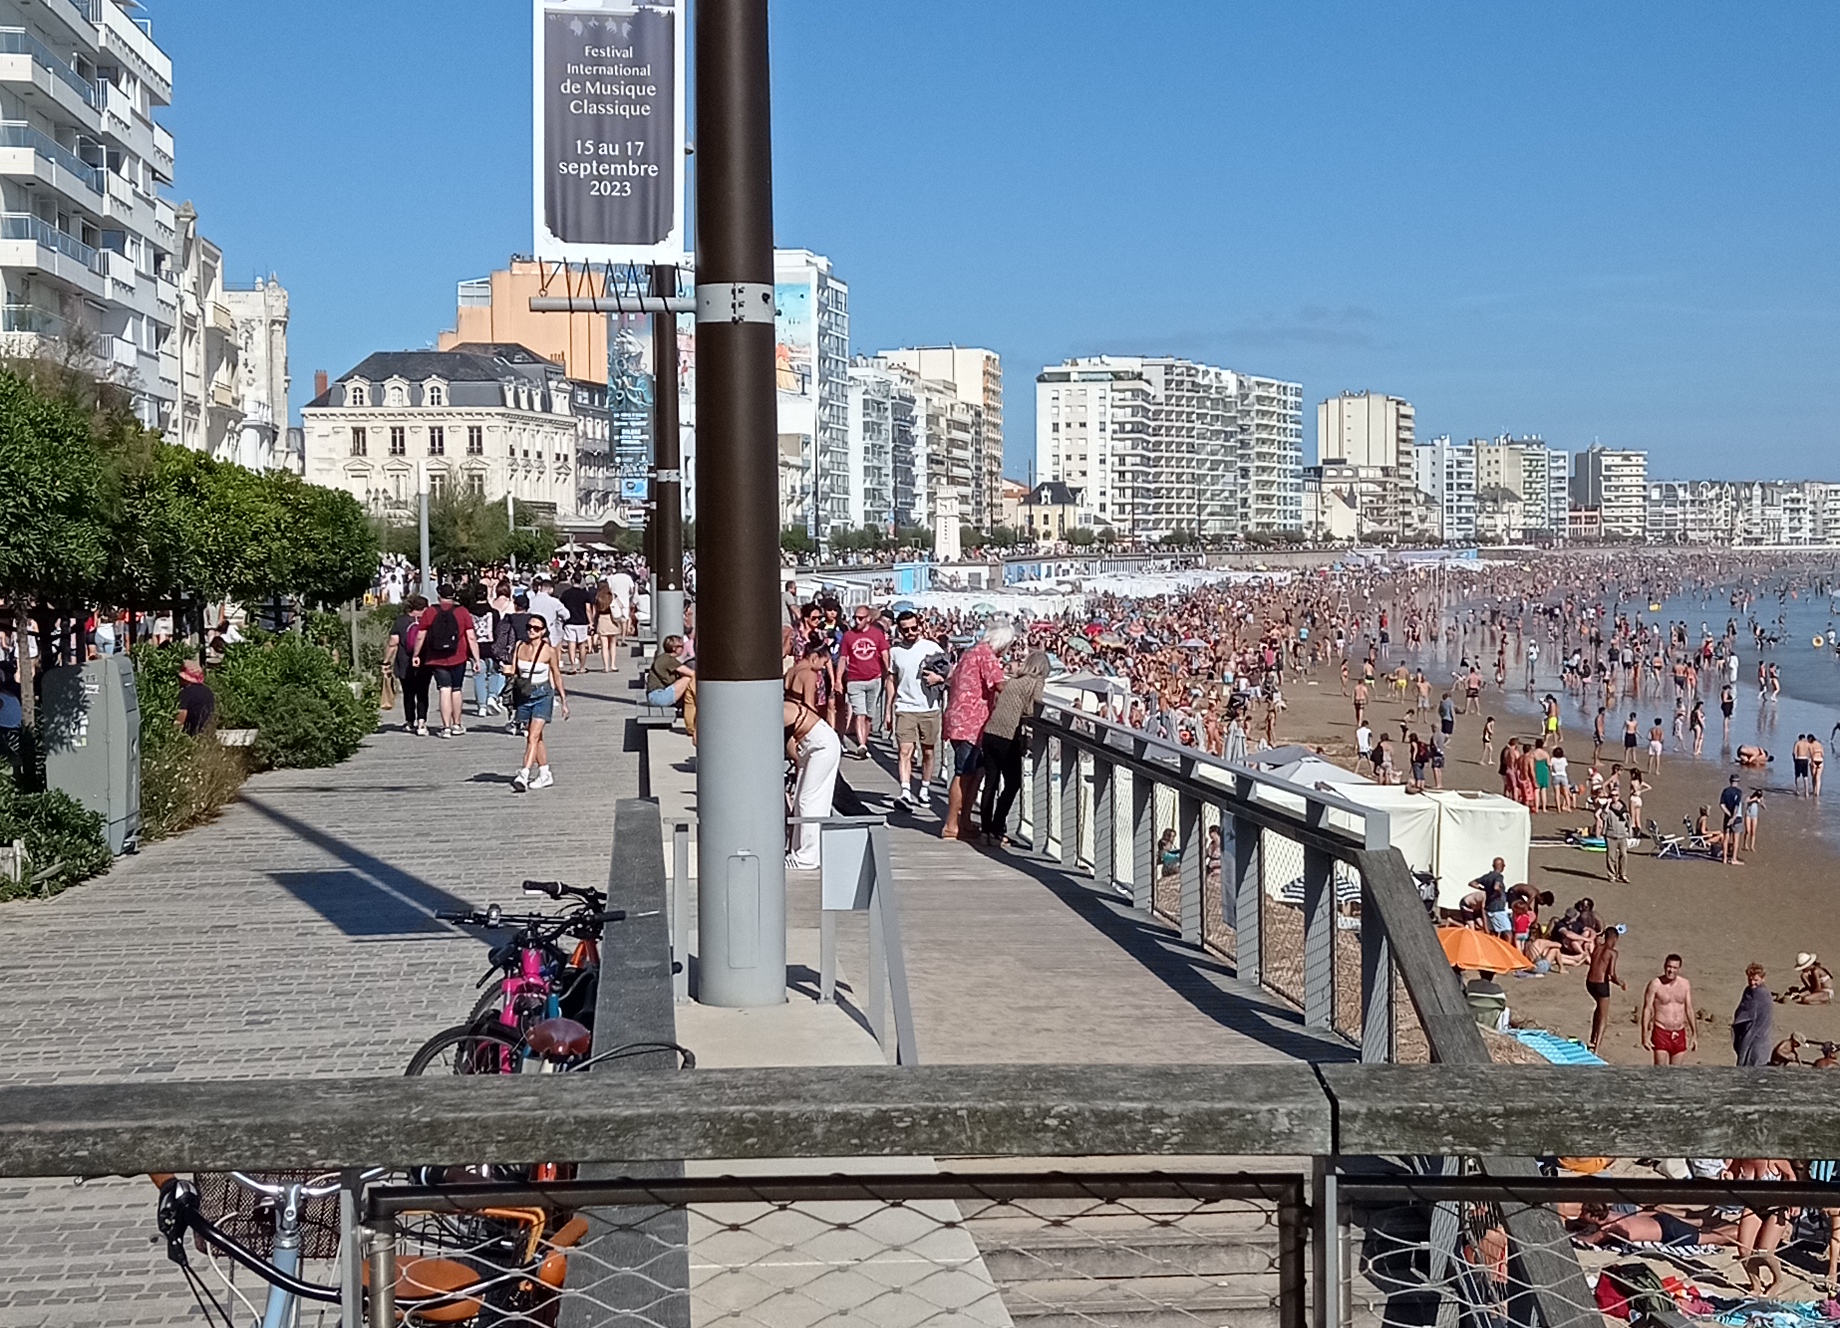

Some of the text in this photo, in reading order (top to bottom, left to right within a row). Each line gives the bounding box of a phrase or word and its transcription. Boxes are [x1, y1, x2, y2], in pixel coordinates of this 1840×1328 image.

[584, 45, 634, 58] Festival
[567, 63, 651, 76] International
[561, 79, 656, 99] de Musique
[569, 99, 651, 118] Classique
[576, 139, 644, 156] 15 au 17
[559, 160, 658, 178] septembre
[590, 181, 631, 196] 2023
